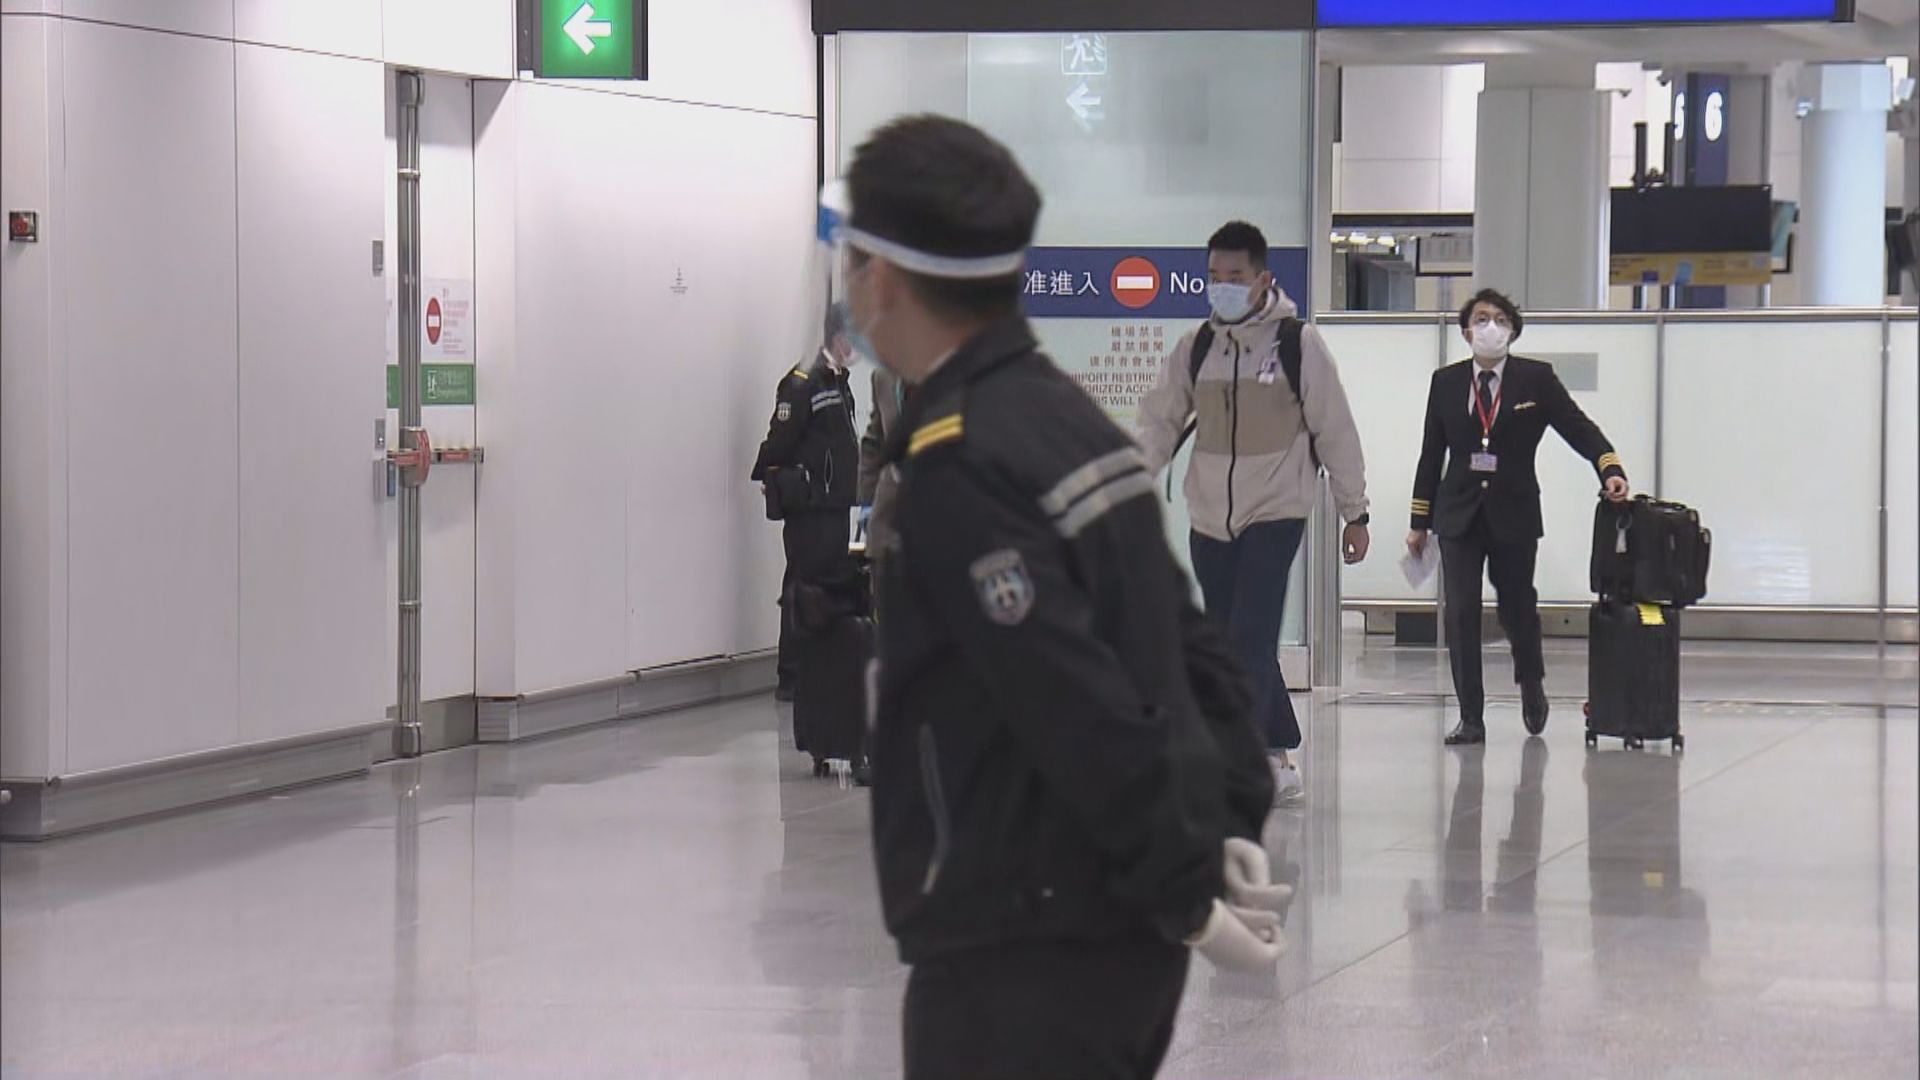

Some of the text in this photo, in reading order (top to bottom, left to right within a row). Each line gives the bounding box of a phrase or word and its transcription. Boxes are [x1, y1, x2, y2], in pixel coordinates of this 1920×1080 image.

[1704, 91, 1723, 142] 6
[1023, 270, 1100, 297] 准進入
[1169, 271, 1205, 295] No
[1109, 395, 1135, 406] WILL
